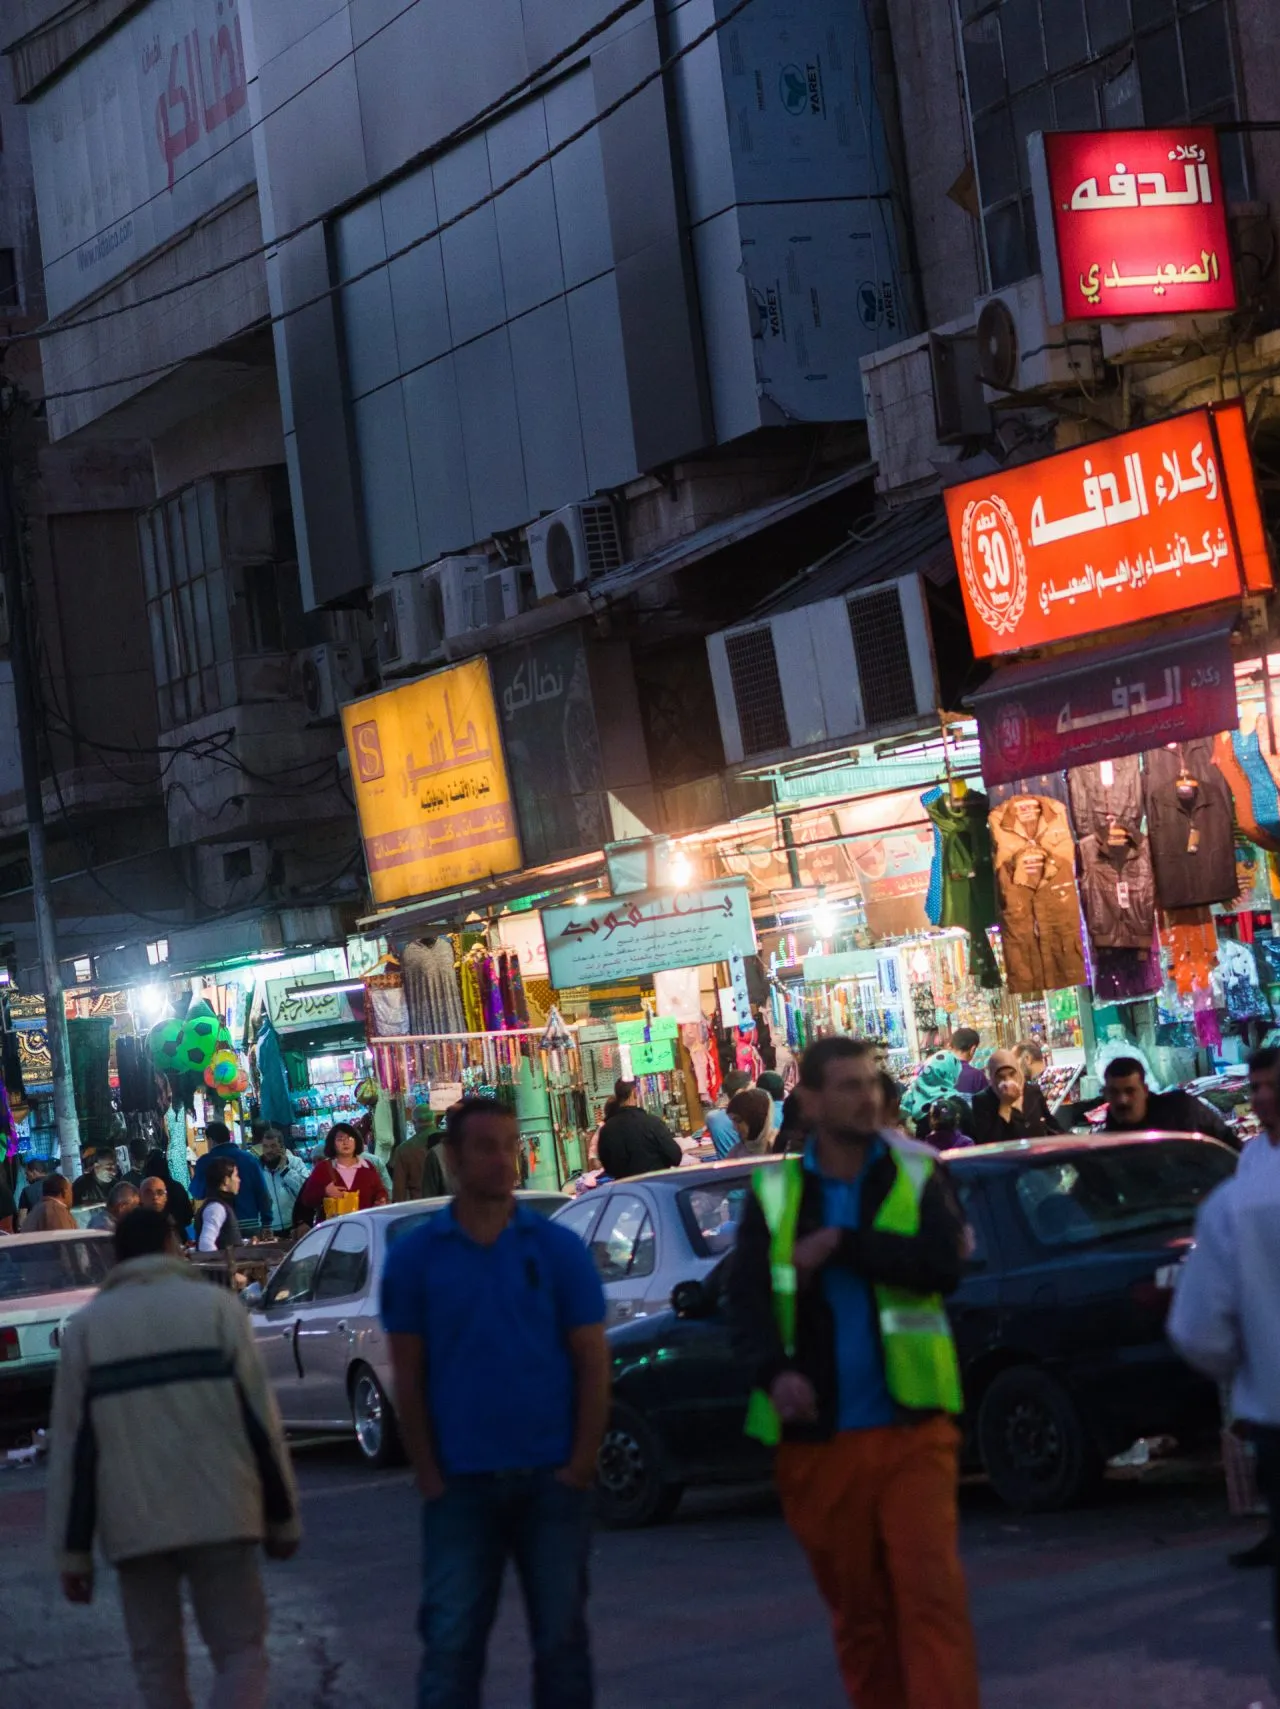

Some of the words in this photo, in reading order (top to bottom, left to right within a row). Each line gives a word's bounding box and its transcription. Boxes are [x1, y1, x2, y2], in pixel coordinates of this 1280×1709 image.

[1167, 144, 1206, 162] وكلاء
[1070, 162, 1213, 211] الدفه
[1079, 248, 1220, 304] الصعيدي
[1030, 452, 1149, 547] الدفه
[1155, 441, 1220, 510] وكلاء
[977, 530, 1011, 590] 30
[1183, 530, 1230, 568] شركة
[1037, 564, 1098, 616] الصعيدي
[502, 657, 564, 722] نضالكو
[1056, 665, 1183, 735] الدفه
[1002, 716, 1021, 748] 30
[560, 891, 733, 942] يعقوب
